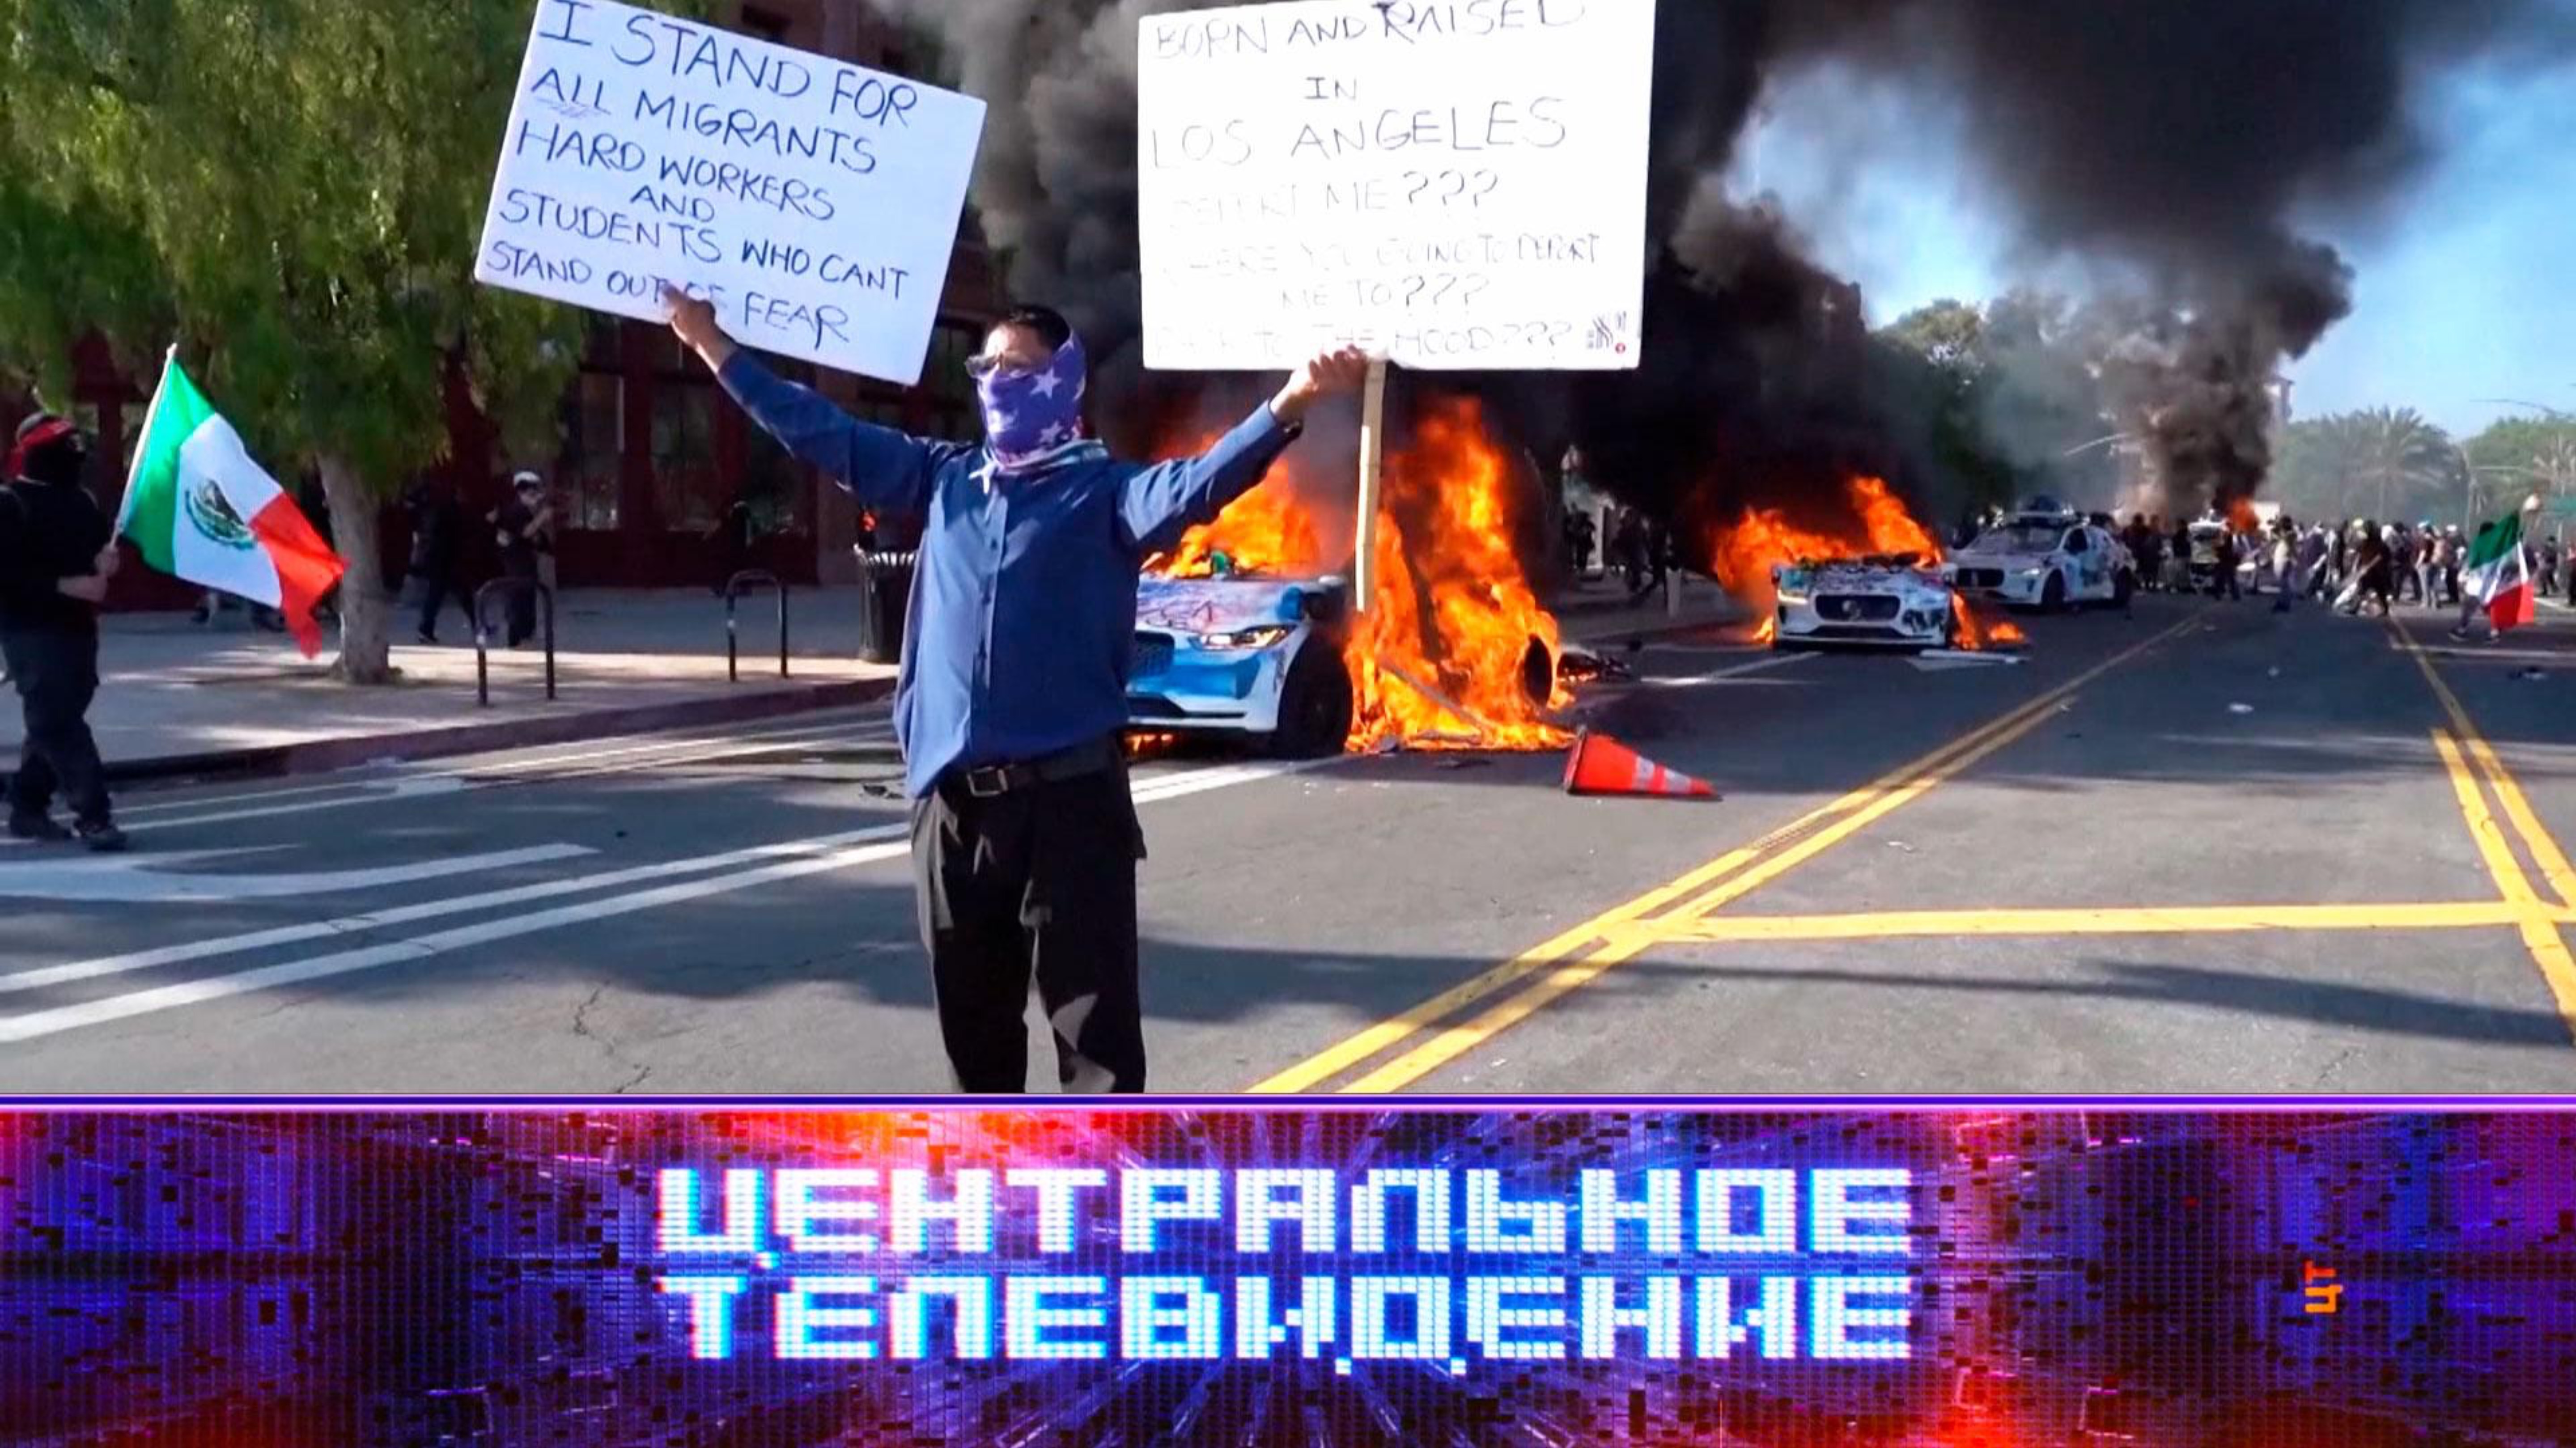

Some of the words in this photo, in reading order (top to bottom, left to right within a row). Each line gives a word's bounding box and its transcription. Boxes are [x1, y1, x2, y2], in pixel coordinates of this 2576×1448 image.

[538, 0, 593, 46] I
[611, 15, 811, 97] STAND
[831, 68, 918, 129] FOR
[1155, 17, 1269, 59] BORN
[1287, 15, 1367, 47] AND
[531, 67, 611, 114] ALL
[635, 90, 878, 174] MIGRANTS
[1152, 119, 1252, 169] LOS
[1290, 96, 1566, 159] ANGELES
[1303, 75, 1358, 101] IN
[517, 120, 645, 173] HARD
[661, 156, 836, 221] WORKERS
[630, 185, 716, 223] AND
[485, 239, 592, 285] STAND
[607, 270, 669, 303] OUT
[744, 291, 850, 350] FEAR
[498, 189, 721, 263] STUDENTS
[742, 239, 811, 274] WHO
[819, 254, 910, 299] CANT
